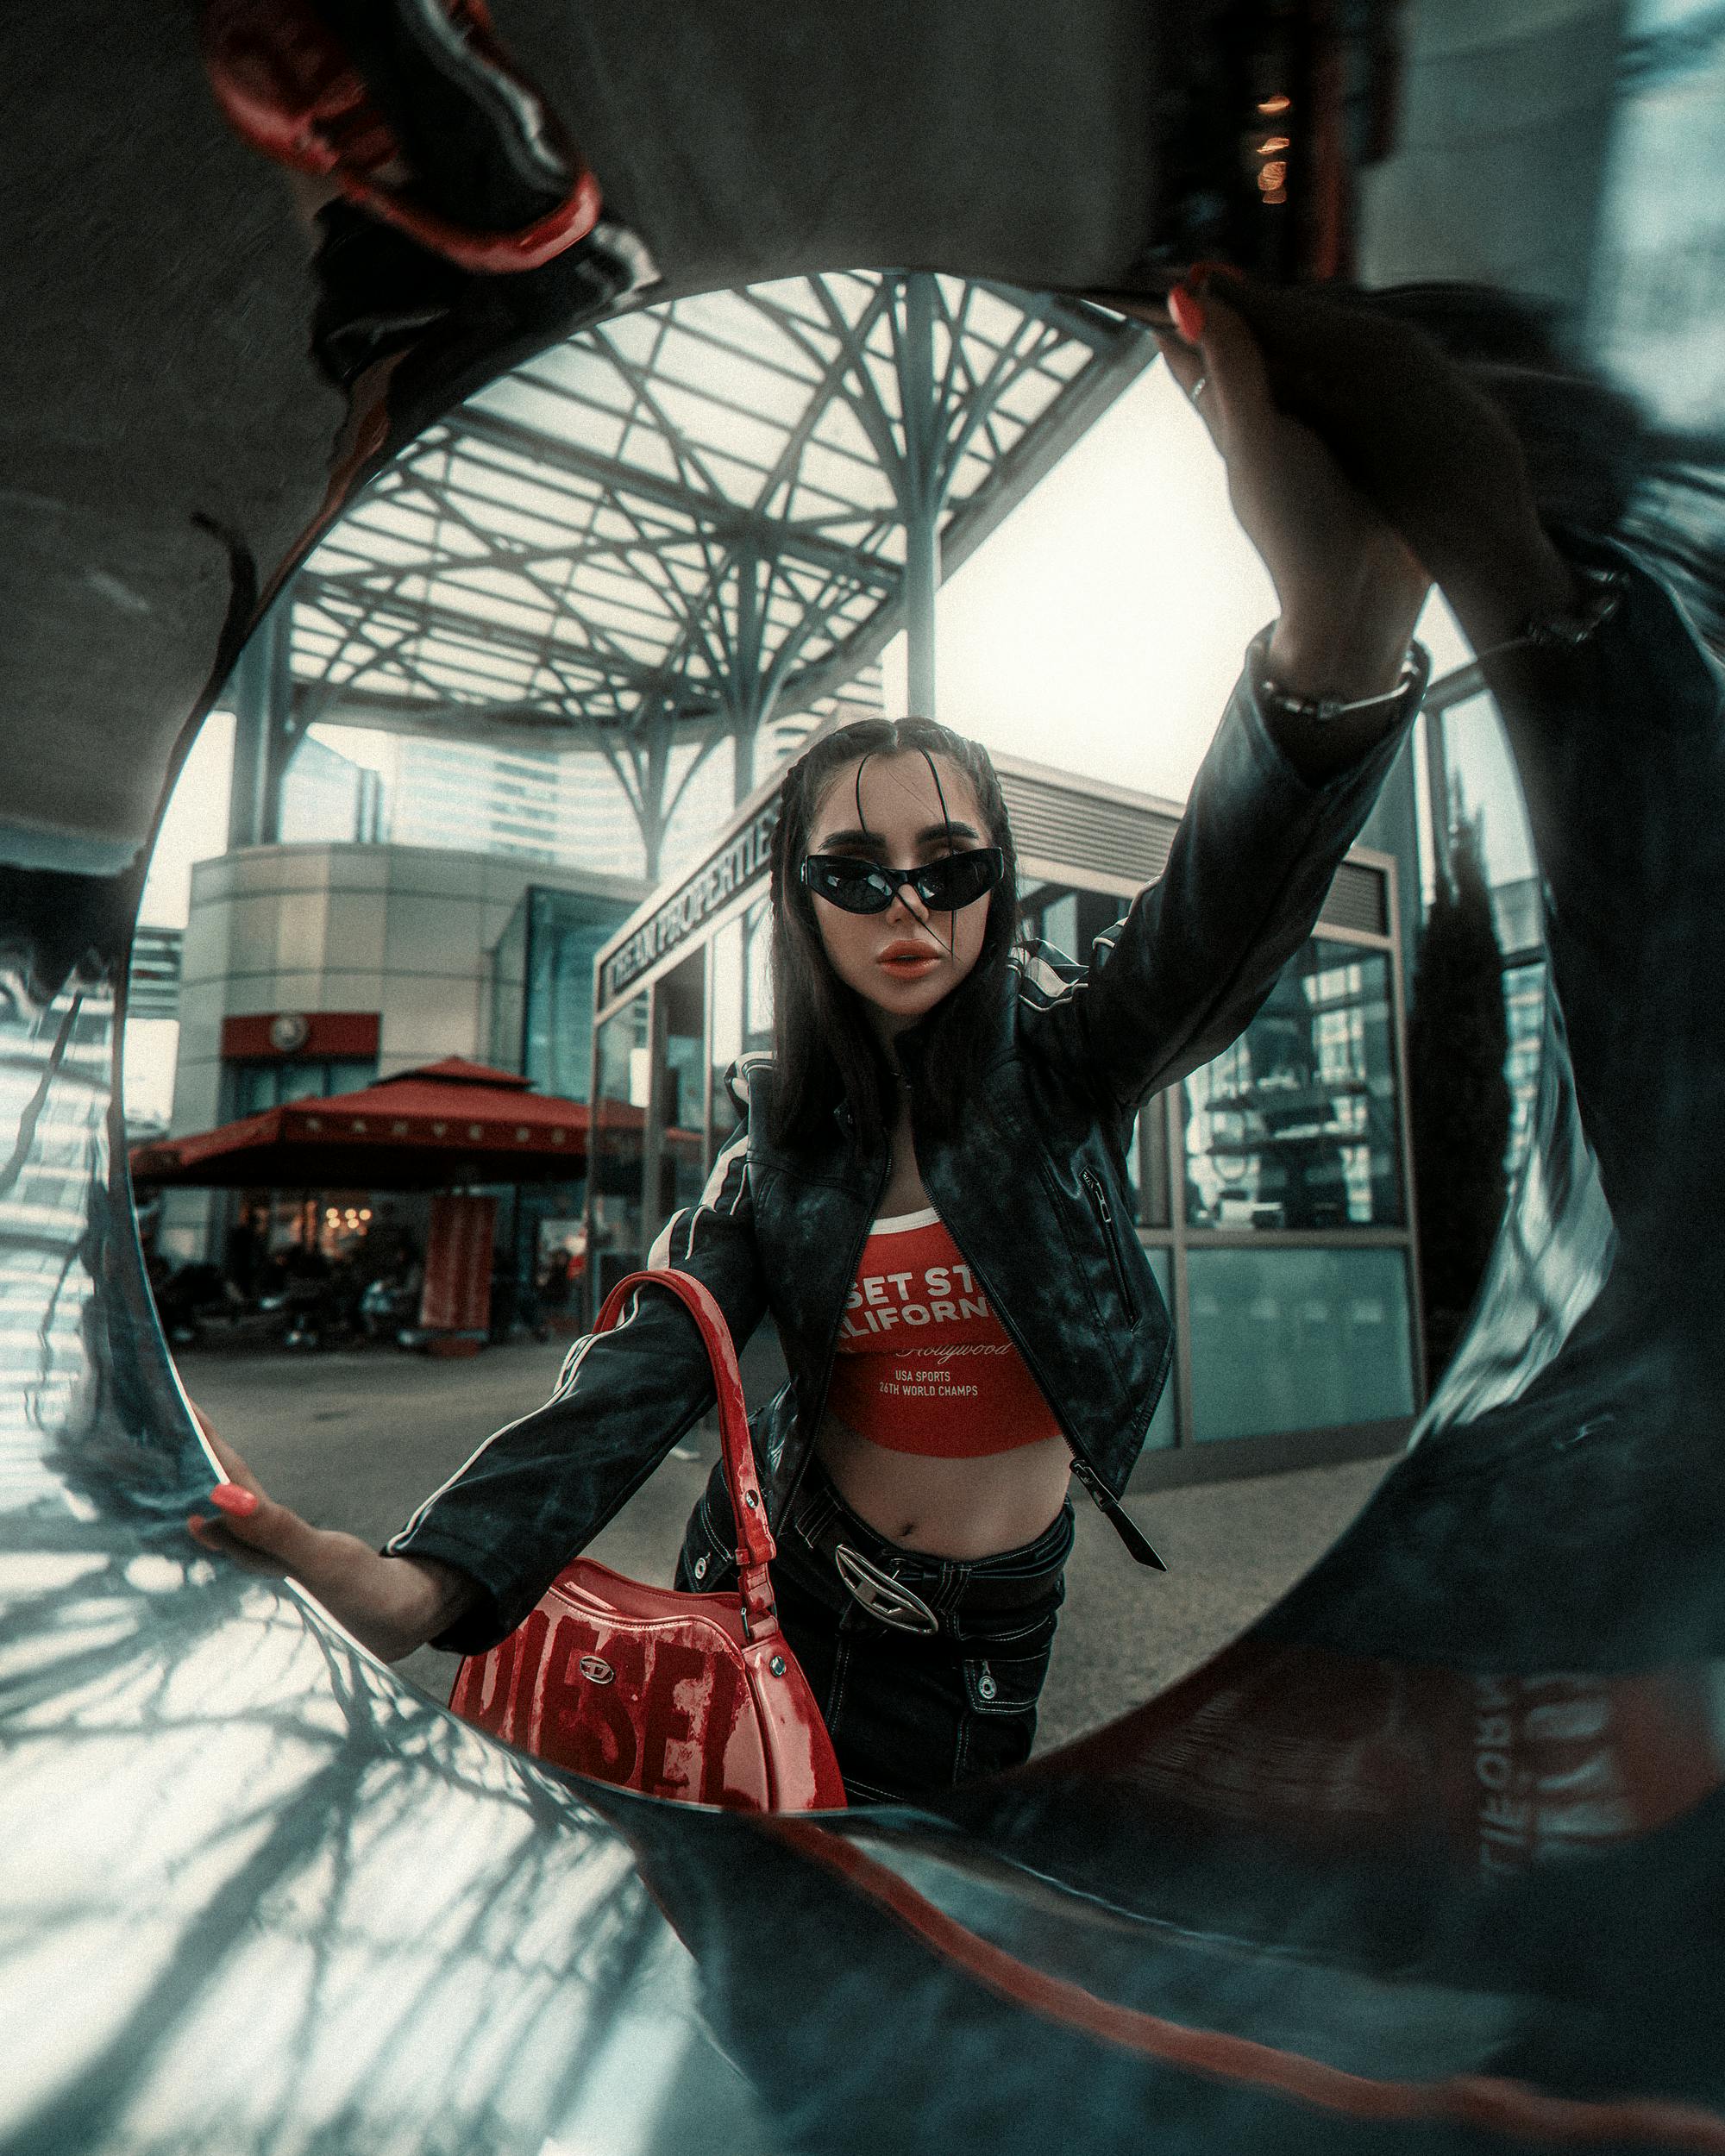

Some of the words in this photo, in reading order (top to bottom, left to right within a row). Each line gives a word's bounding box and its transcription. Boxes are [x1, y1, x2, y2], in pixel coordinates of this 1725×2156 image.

[895, 1369, 913, 1382] USA
[916, 1371, 951, 1382] SPORTS
[879, 1382, 900, 1395] 26TH
[902, 1385, 936, 1396] WORLD
[938, 1385, 979, 1396] CHAMPS
